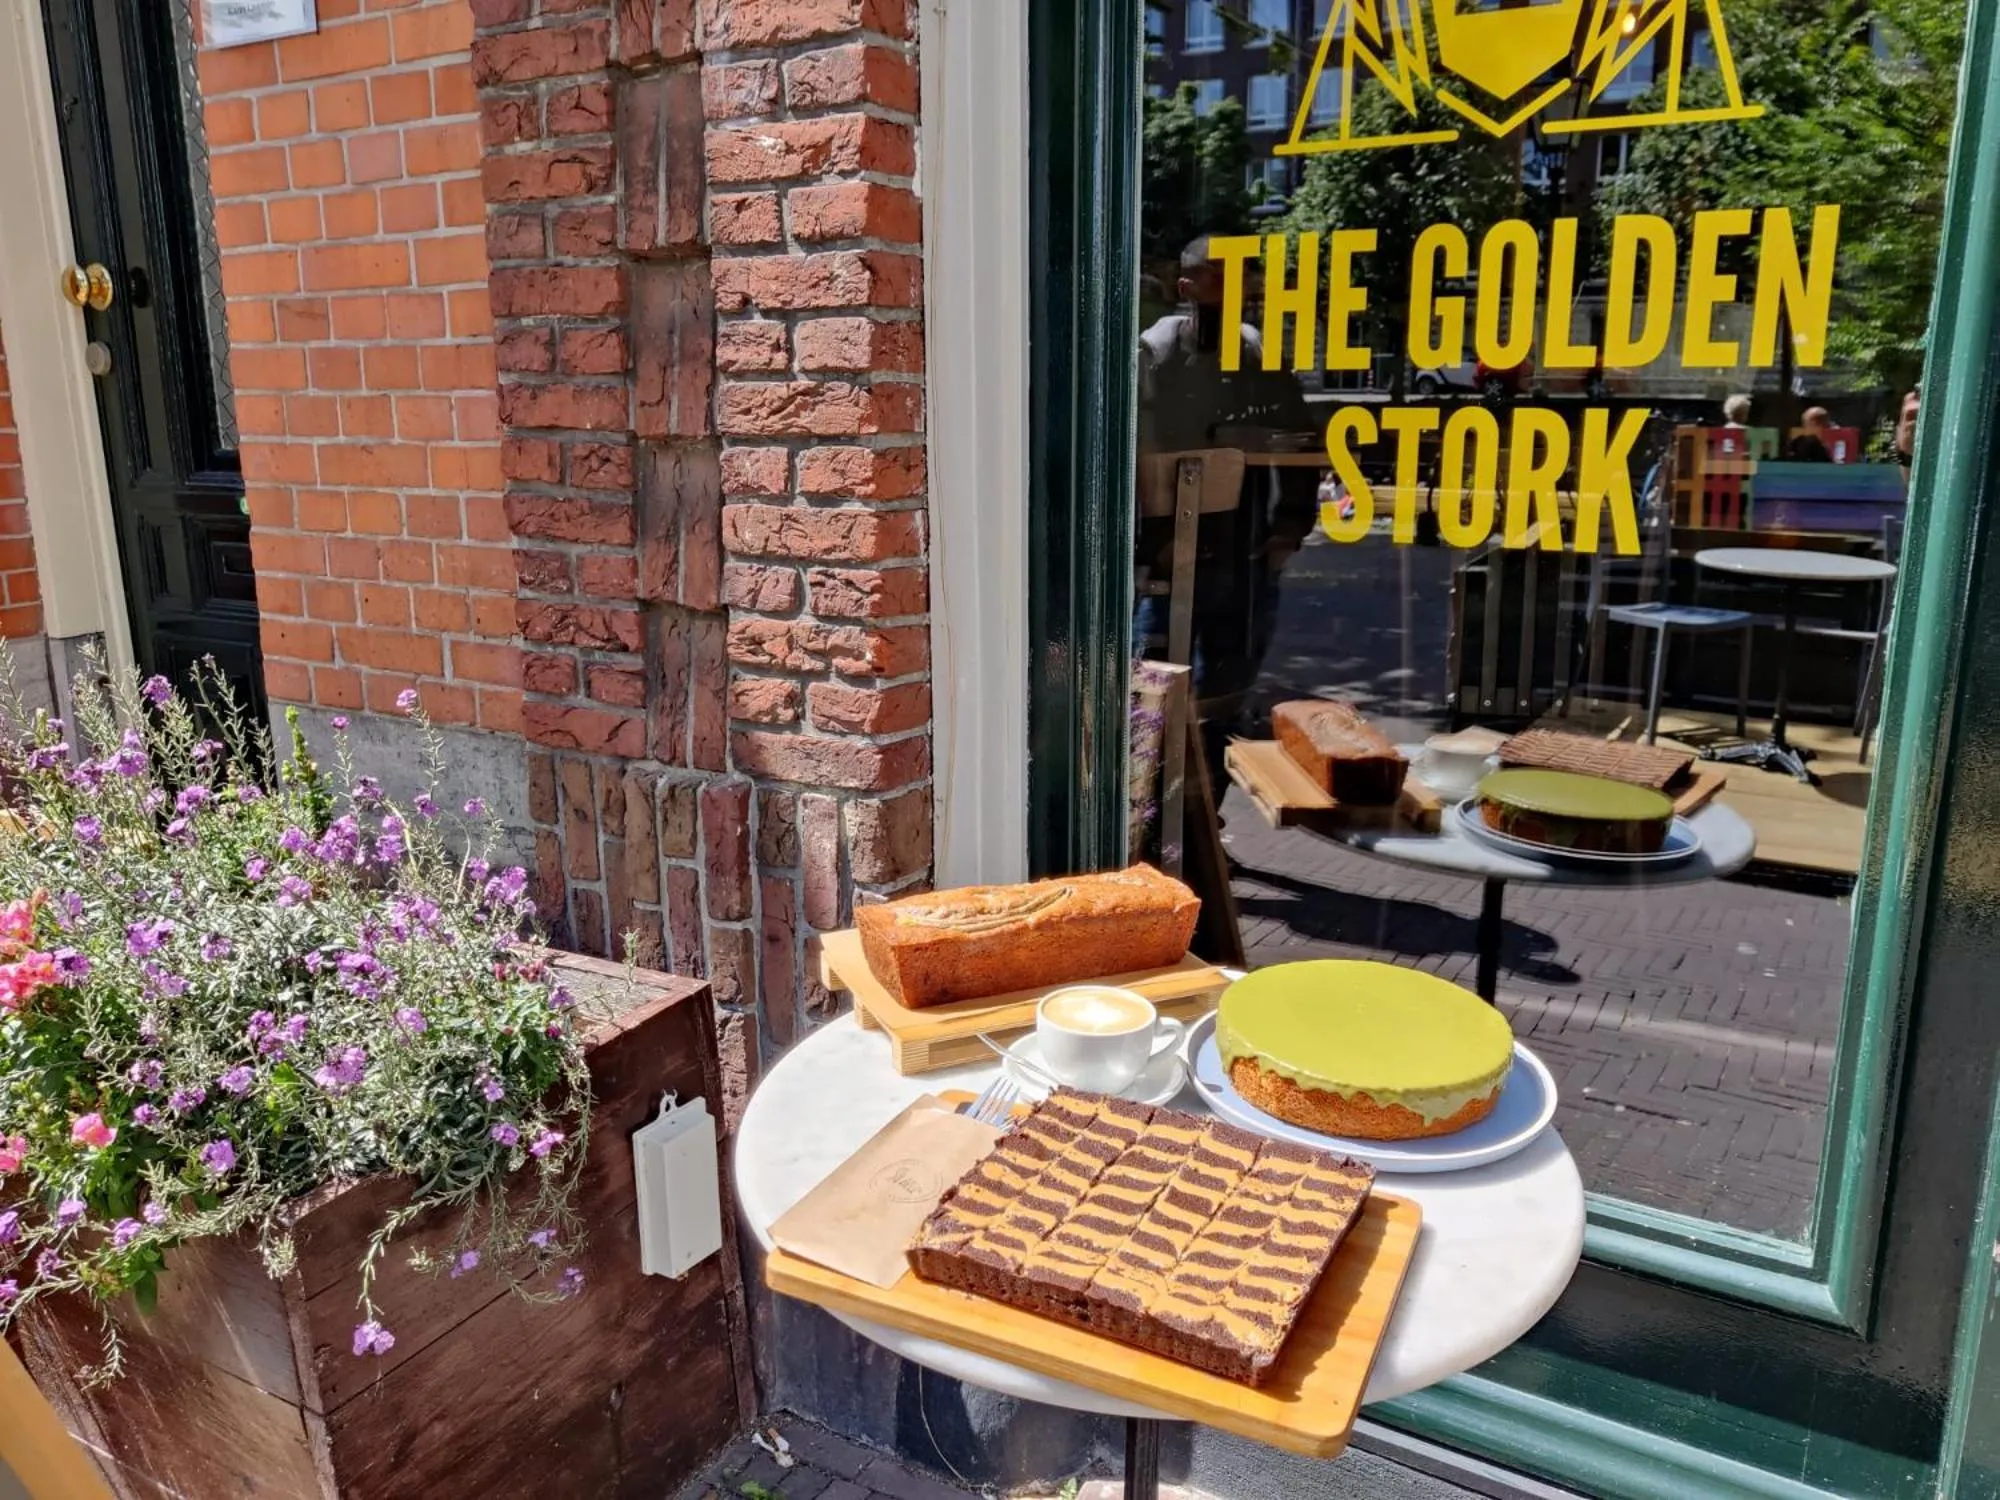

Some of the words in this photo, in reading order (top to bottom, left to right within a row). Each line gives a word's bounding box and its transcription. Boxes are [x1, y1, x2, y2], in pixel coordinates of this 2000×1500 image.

[1208, 229, 1377, 371] THE
[1407, 204, 1840, 370] GOLDEN
[1319, 406, 1650, 555] STORK
